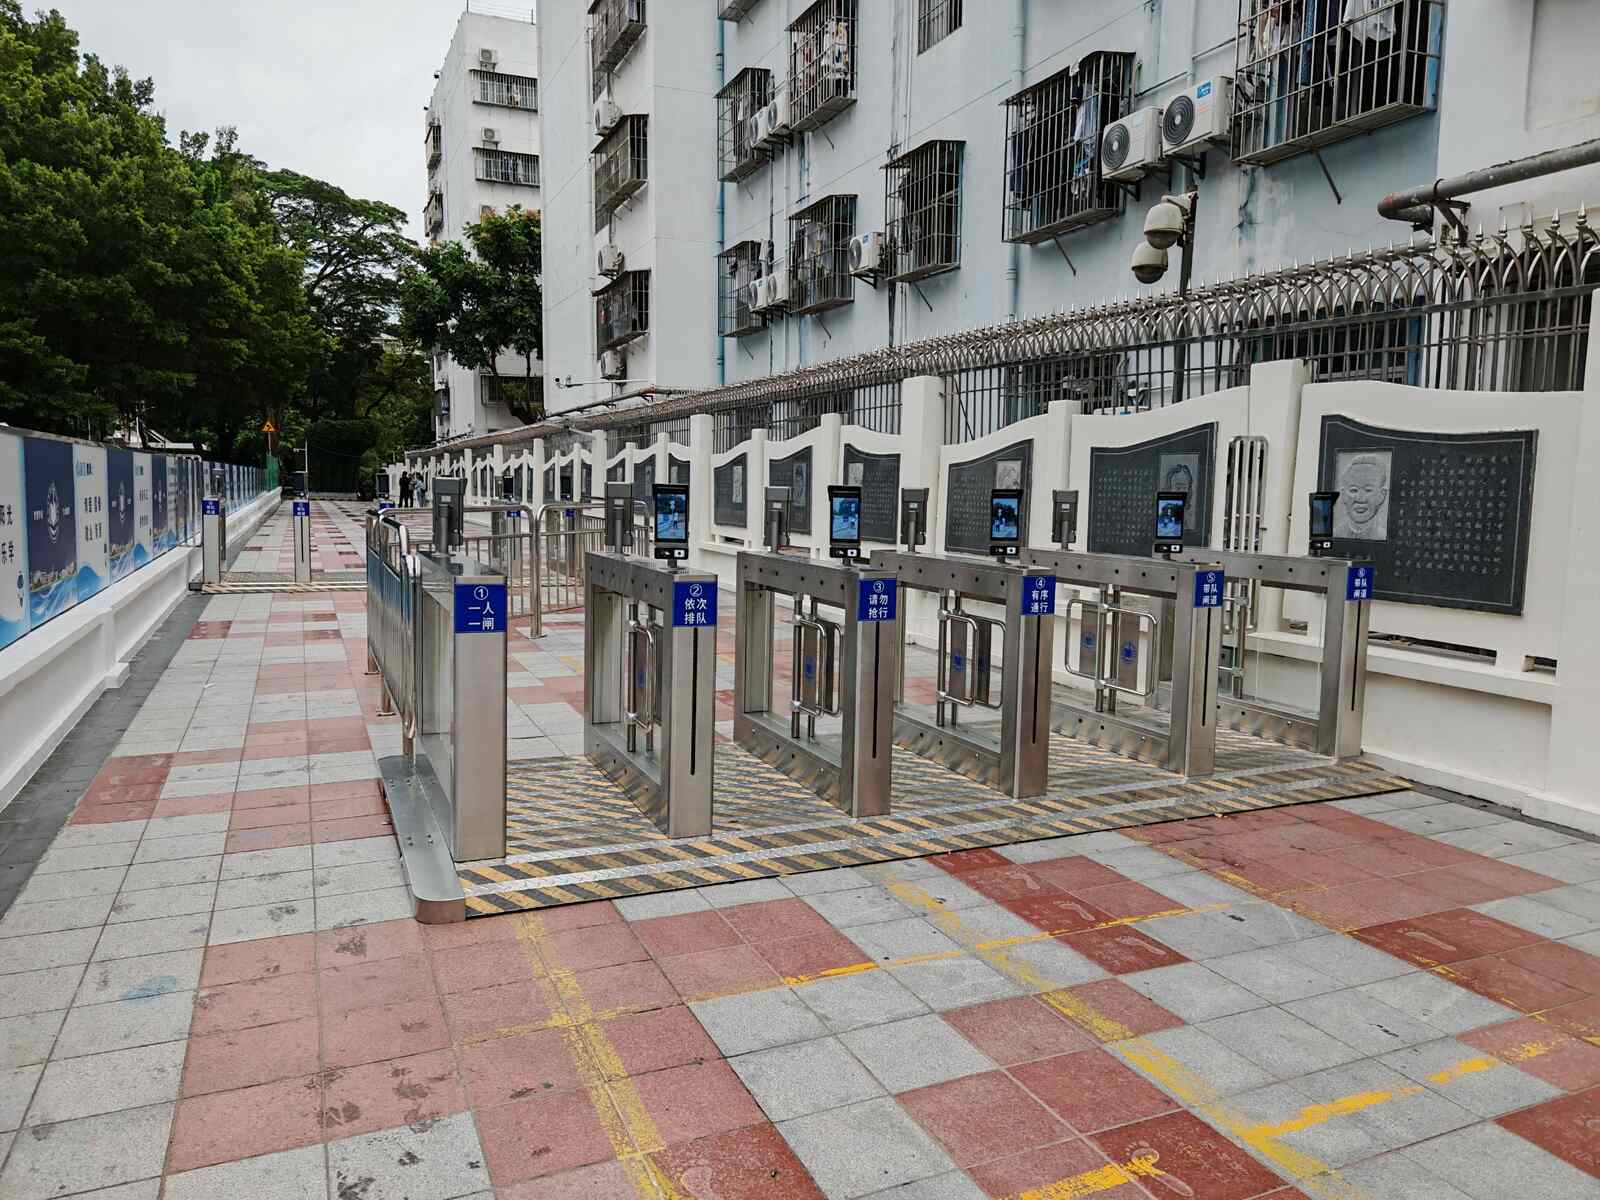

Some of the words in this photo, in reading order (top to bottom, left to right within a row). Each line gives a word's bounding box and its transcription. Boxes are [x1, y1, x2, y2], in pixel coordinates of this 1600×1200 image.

[868, 594, 889, 606] 请勿
[1031, 590, 1049, 601] 有序
[467, 601, 495, 616] 一人
[684, 598, 708, 611] 依次
[1030, 602, 1049, 614] 通行
[684, 611, 708, 625] 排队
[868, 607, 889, 619] 抢行
[467, 617, 495, 631] 一闸
